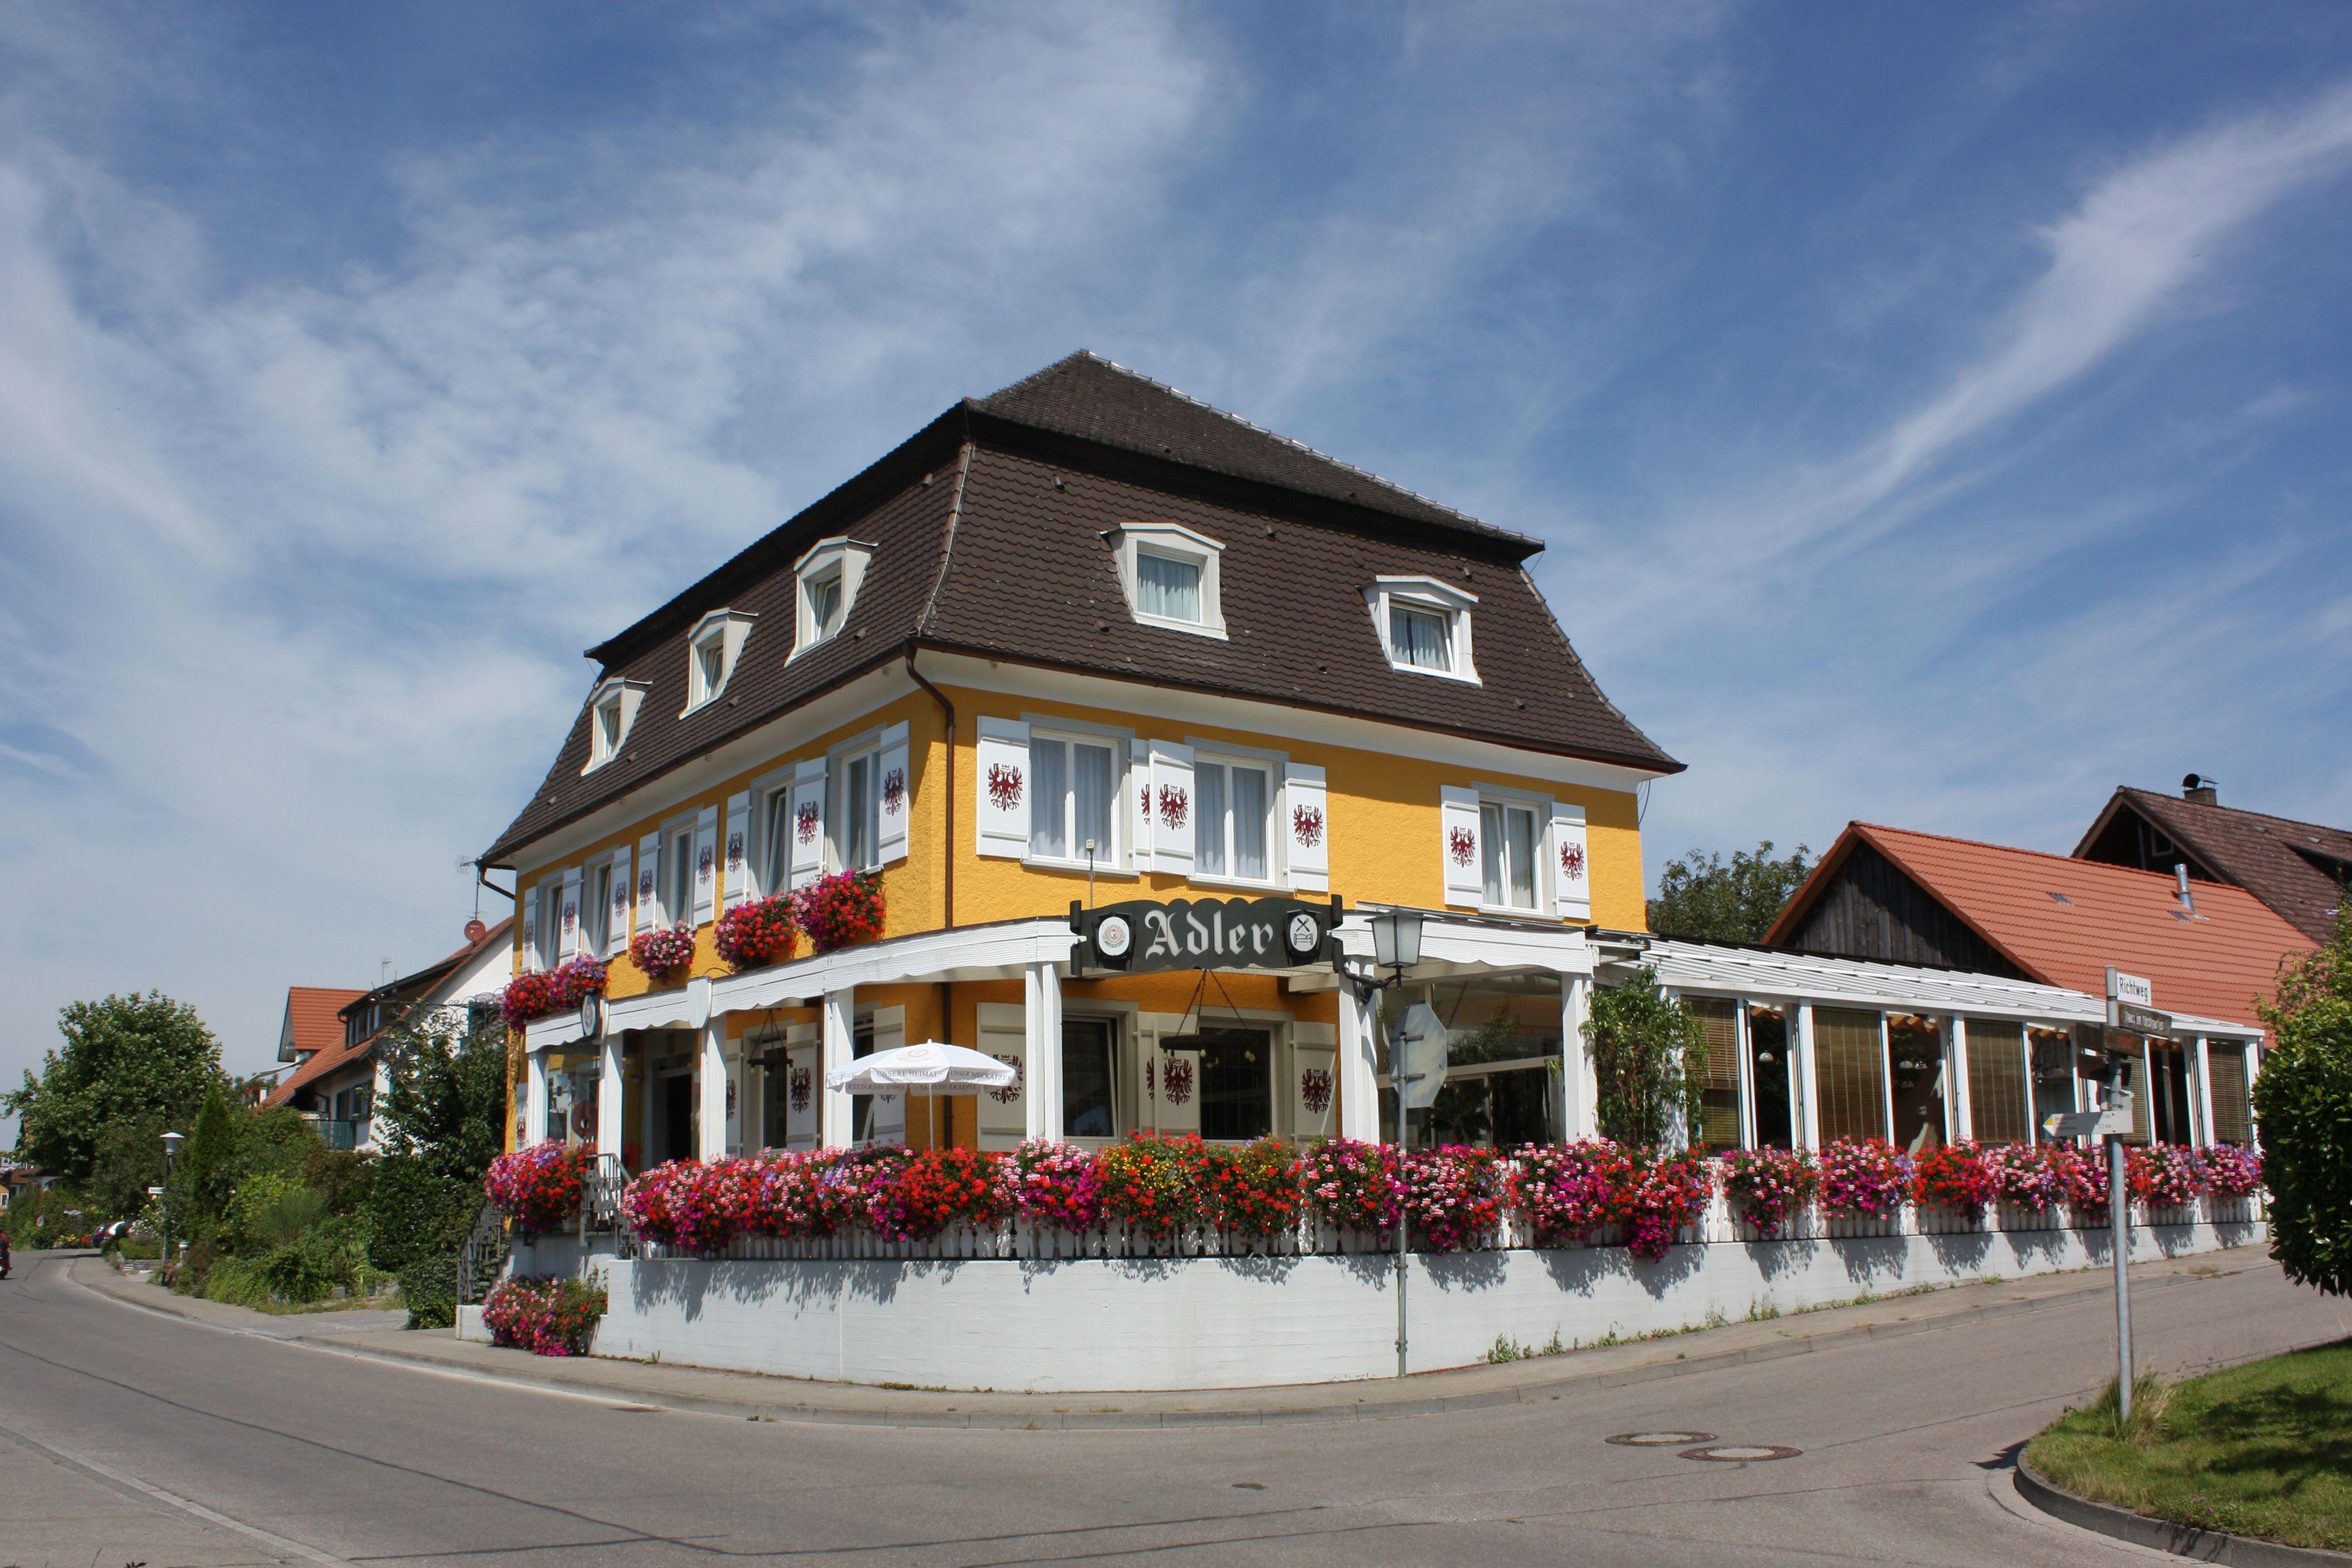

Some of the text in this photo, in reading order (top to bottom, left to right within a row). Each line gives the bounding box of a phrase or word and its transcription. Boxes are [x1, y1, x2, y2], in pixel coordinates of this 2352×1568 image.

[1144, 910, 1273, 960] Adler
[2119, 977, 2148, 1002] Richtweg
[971, 1071, 1013, 1081] MECKATZER
